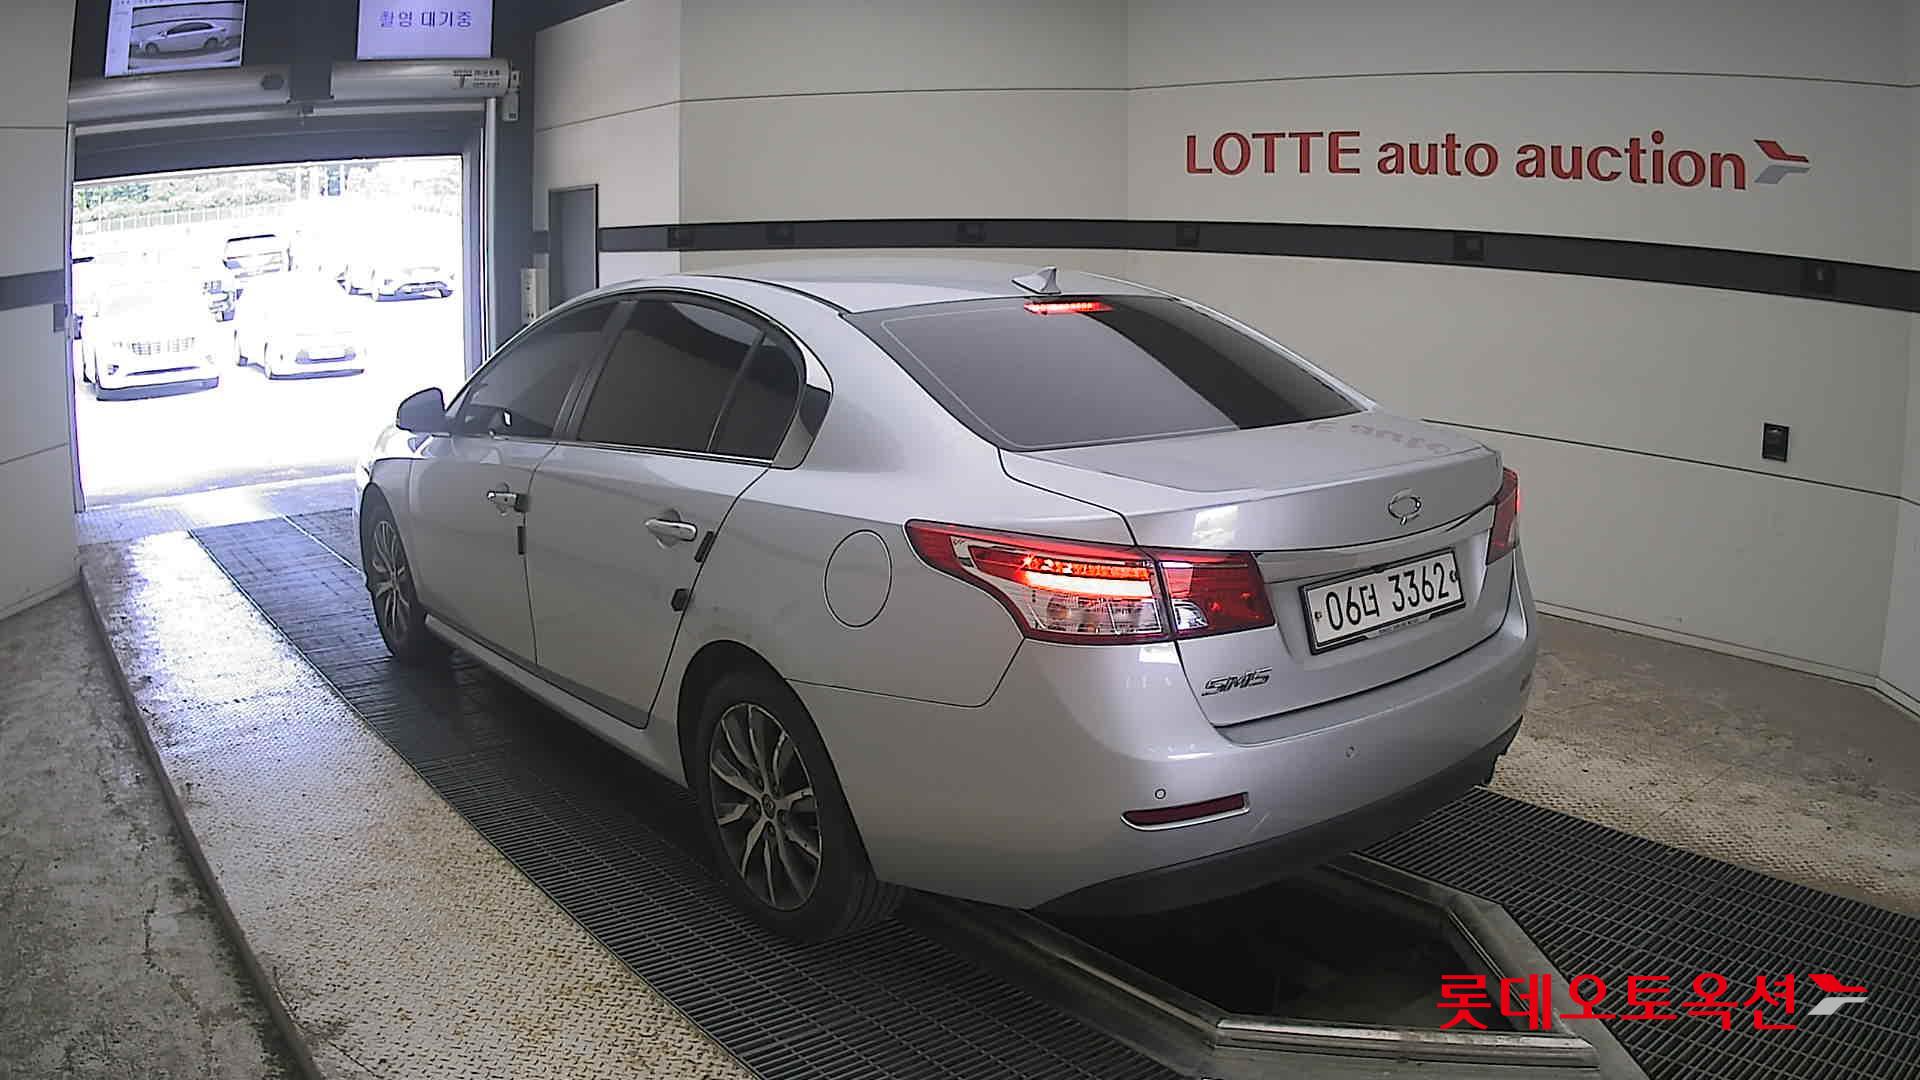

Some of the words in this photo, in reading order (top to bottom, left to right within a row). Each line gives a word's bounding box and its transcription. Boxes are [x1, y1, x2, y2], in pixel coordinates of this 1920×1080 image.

[421, 9, 472, 28] 대기중
[1186, 131, 1361, 175] LOTTE
[1377, 133, 1499, 176] auto
[1515, 130, 1747, 190] auction
[1325, 583, 1380, 631] 06더
[1388, 562, 1449, 612] 3362
[1201, 666, 1273, 697] SM5
